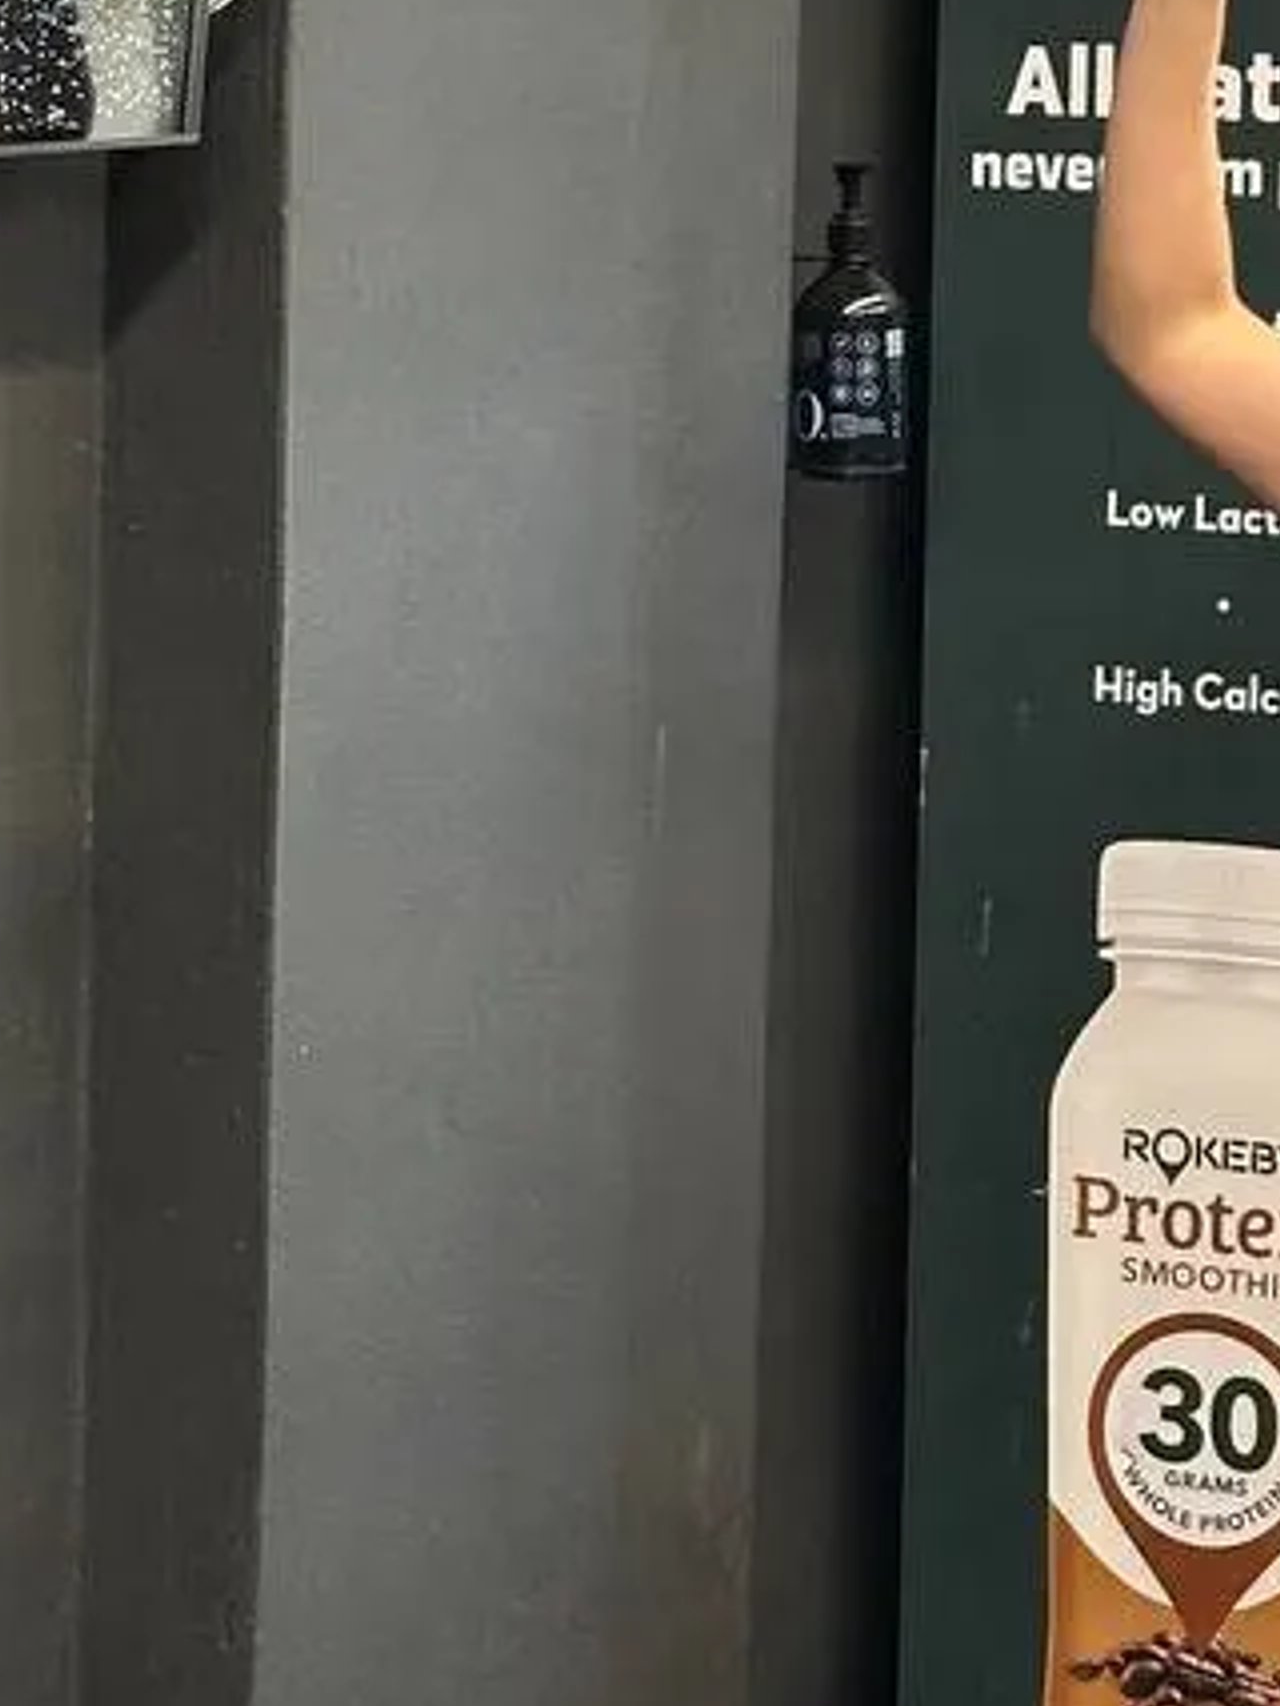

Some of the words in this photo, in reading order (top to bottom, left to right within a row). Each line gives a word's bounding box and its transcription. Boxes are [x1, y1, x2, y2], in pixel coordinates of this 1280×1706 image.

[1007, 43, 1114, 117] All
[971, 151, 1105, 191] neve
[1107, 489, 1185, 531] Low
[1093, 664, 1183, 716] High
[1138, 1367, 1278, 1474] 30
[1164, 1469, 1250, 1497] GRAMS
